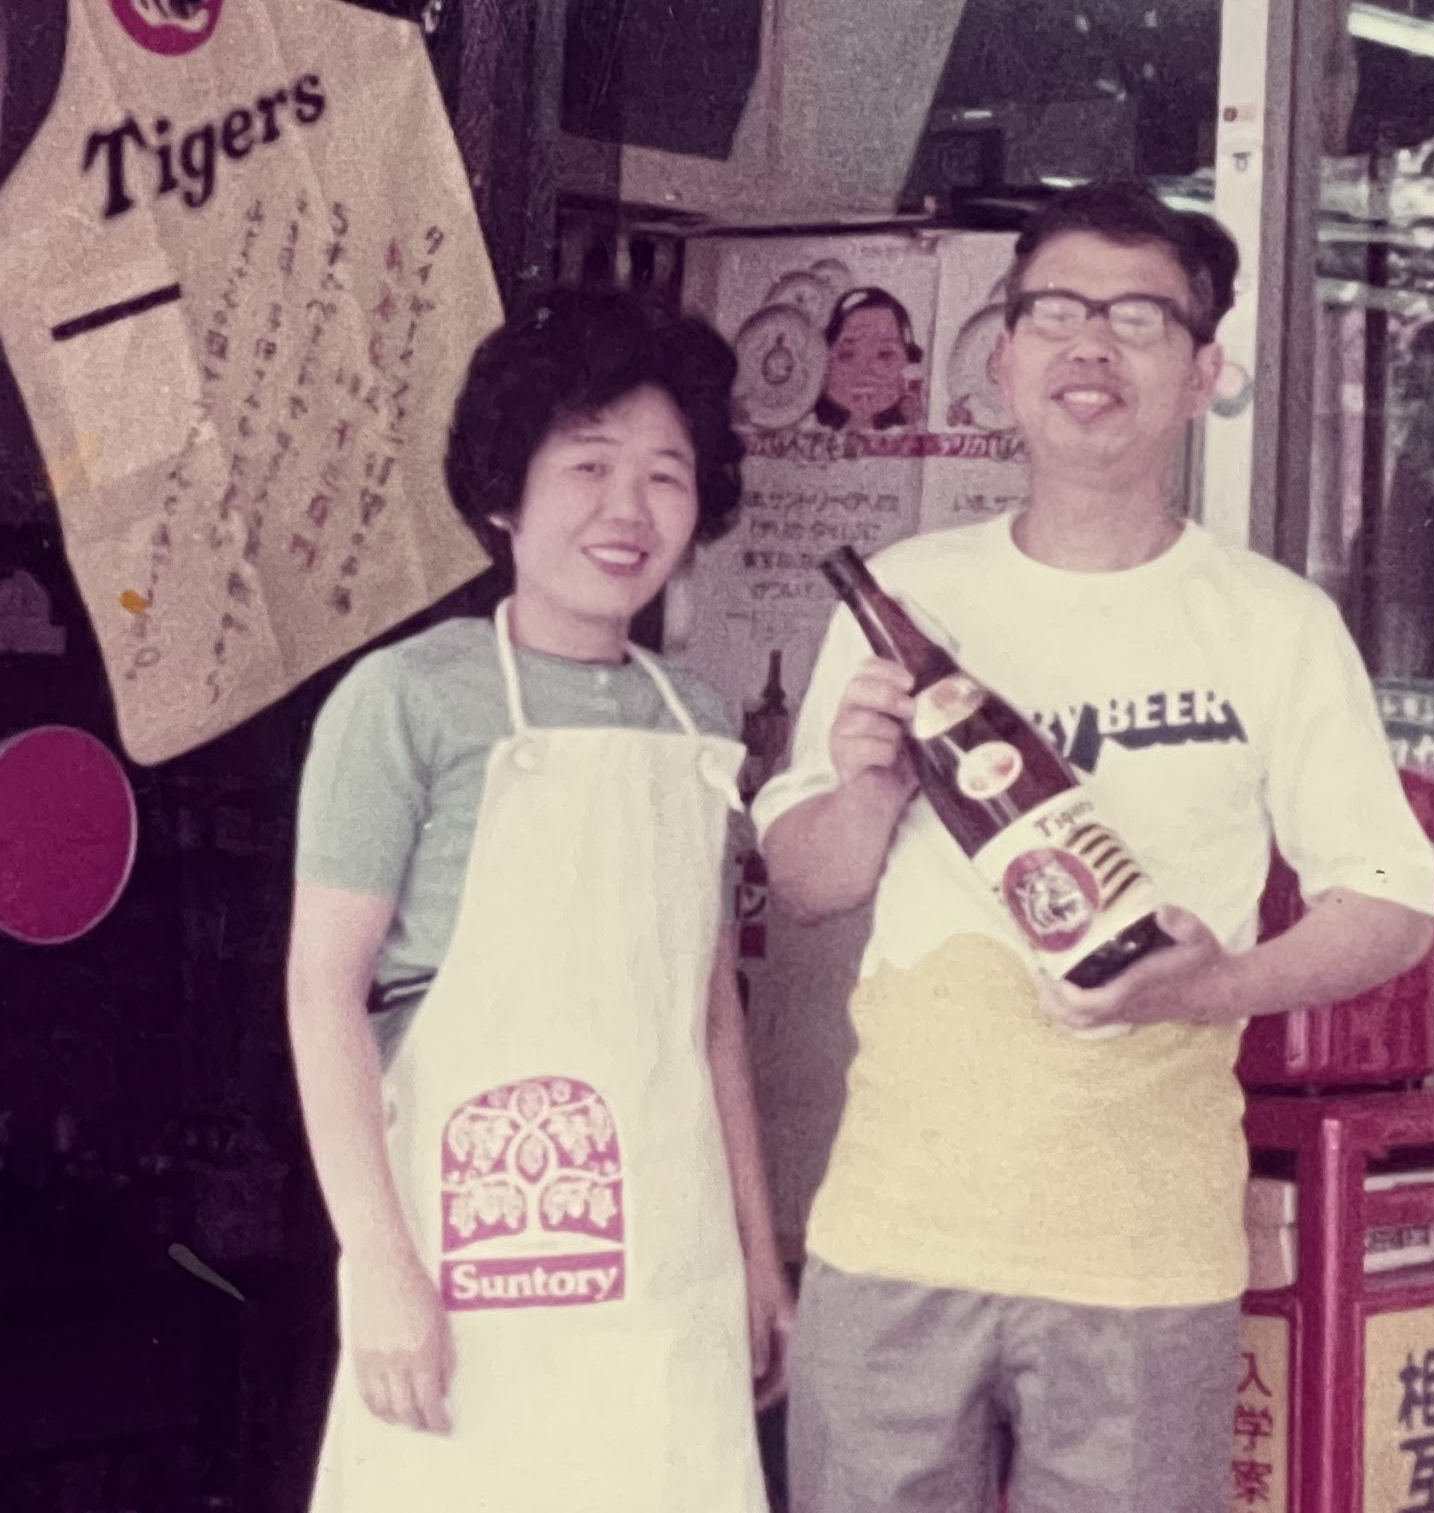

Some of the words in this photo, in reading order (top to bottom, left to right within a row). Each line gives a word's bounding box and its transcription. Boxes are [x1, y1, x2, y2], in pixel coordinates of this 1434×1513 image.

[83, 72, 327, 220] Tigers
[1098, 690, 1248, 752] BEER
[452, 1263, 619, 1300] Suntory
